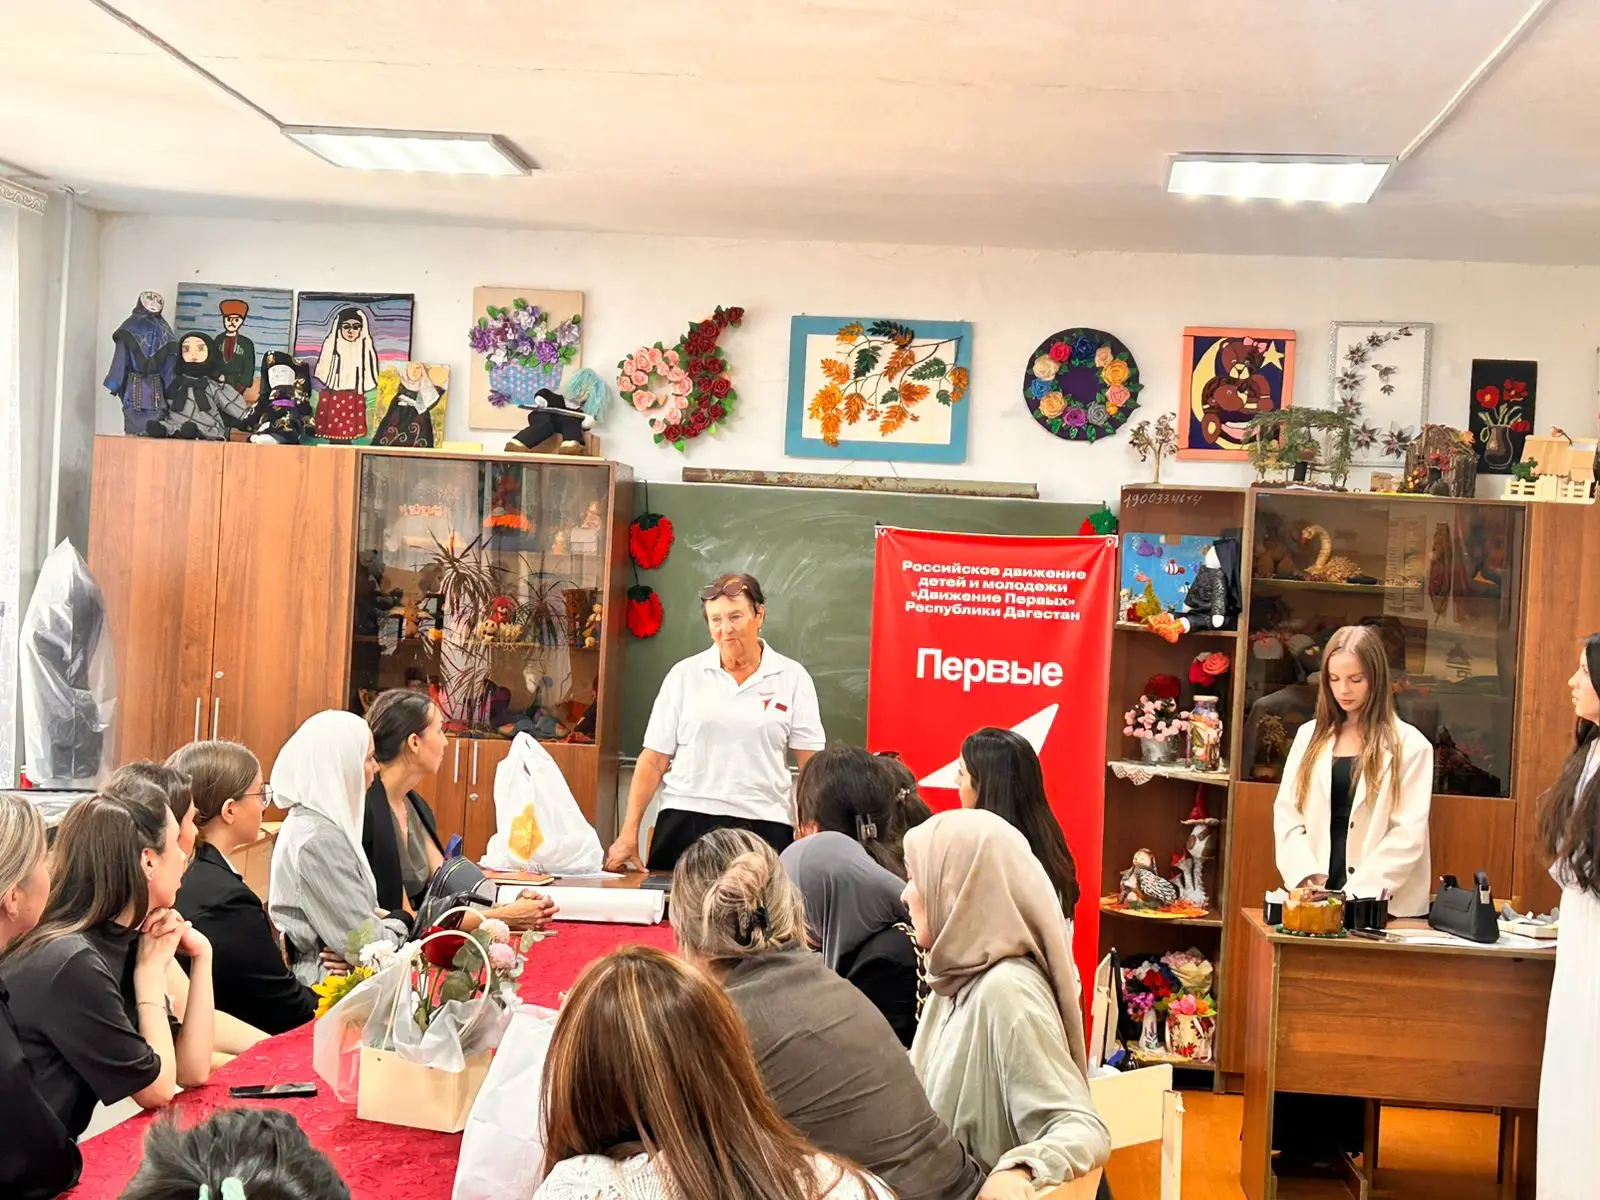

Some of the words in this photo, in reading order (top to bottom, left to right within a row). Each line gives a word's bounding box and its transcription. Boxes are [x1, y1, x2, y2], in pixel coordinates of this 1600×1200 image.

[902, 560, 1000, 577] Российское
[1002, 567, 1087, 580] движение
[918, 576, 967, 589] детей
[969, 580, 980, 588] и
[982, 581, 1068, 593] молодежи
[911, 588, 1002, 604] «Движение
[1004, 593, 1076, 607] Первых»
[905, 601, 1001, 617] Республики
[1003, 606, 1081, 621] Дагестан
[916, 647, 1064, 692] Первые
